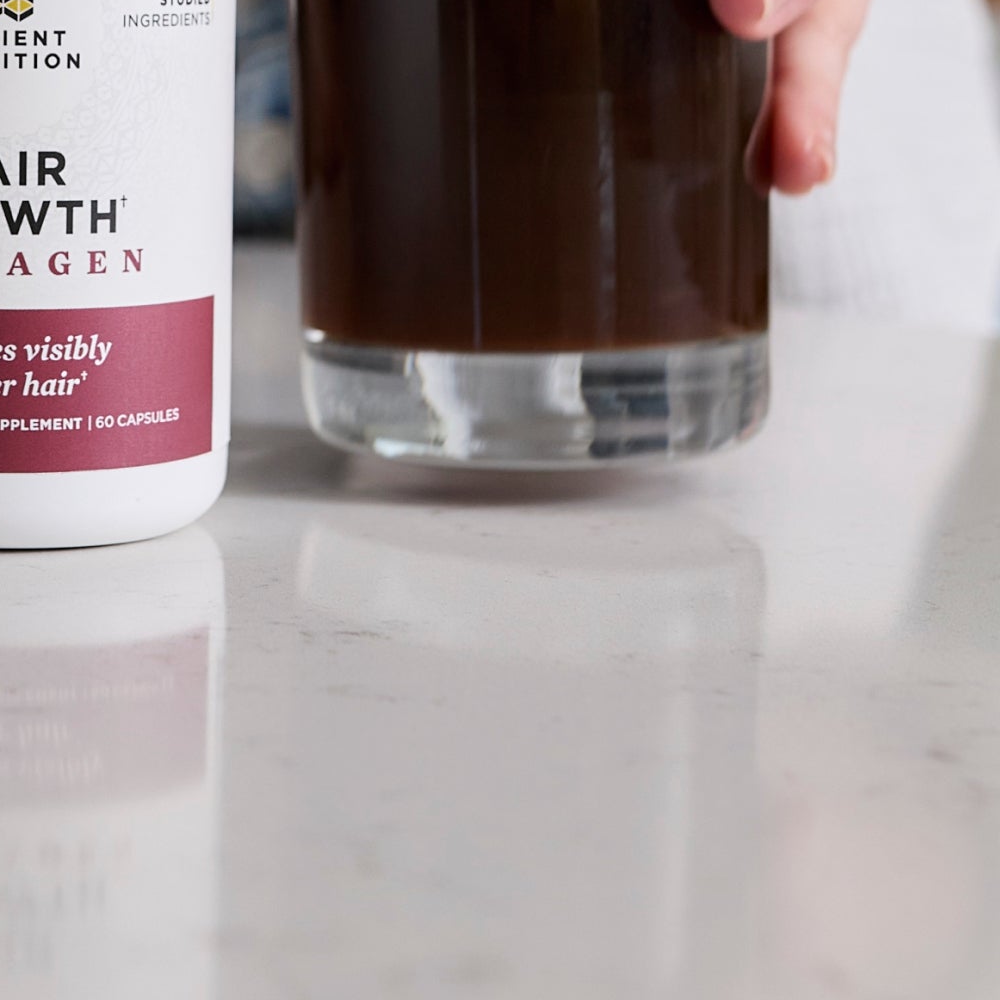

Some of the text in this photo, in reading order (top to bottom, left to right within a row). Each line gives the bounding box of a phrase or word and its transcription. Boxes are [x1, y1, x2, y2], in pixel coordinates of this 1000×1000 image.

[122, 11, 211, 28] INGREDIENTS
[23, 334, 112, 365] visibly
[95, 415, 114, 429] 60
[117, 407, 180, 427] CAPSULES
